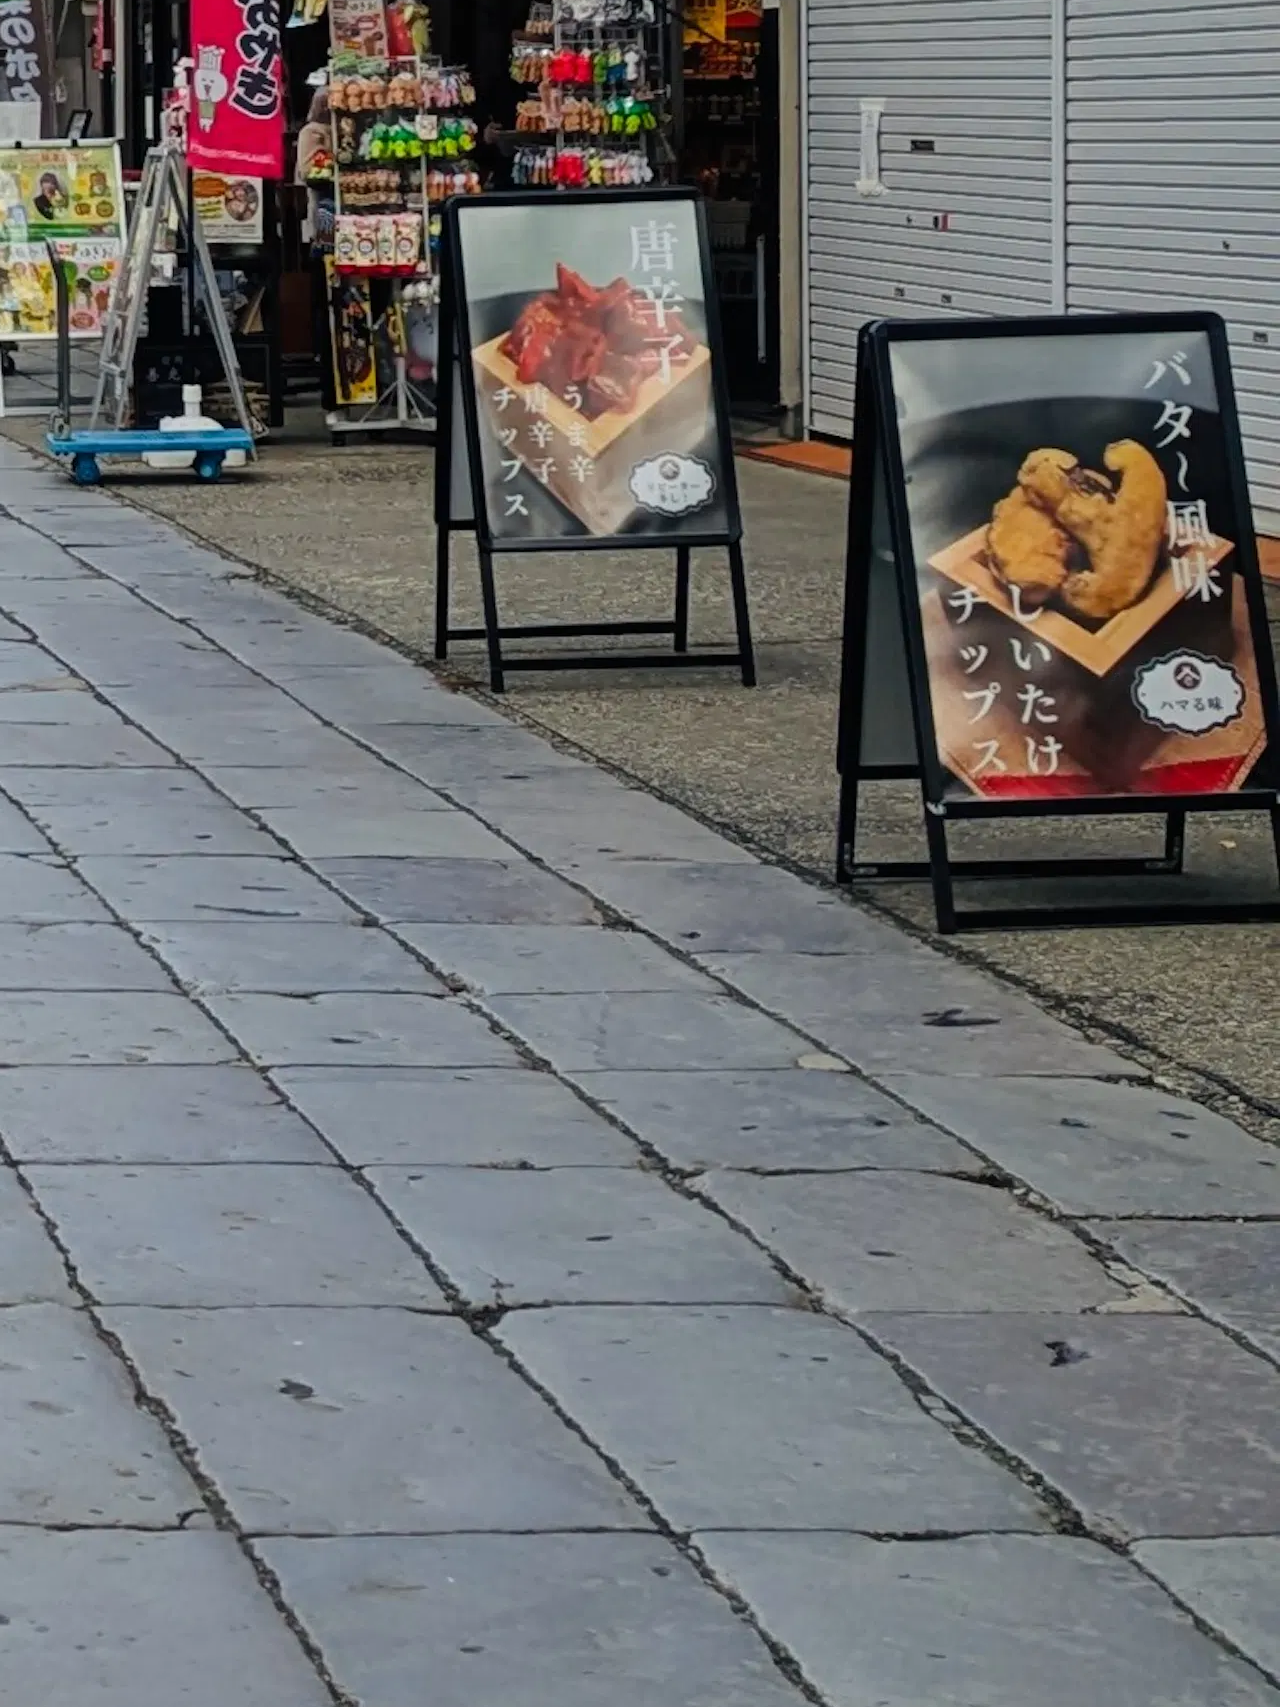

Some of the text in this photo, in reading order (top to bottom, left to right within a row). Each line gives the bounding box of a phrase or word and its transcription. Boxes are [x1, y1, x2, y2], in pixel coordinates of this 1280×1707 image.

[629, 220, 691, 385] 唐辛子
[492, 386, 529, 517] チップス
[524, 387, 558, 484] 唐辛子
[563, 385, 596, 483] うま辛
[948, 587, 1008, 776] チップス
[1007, 584, 1064, 776] しいたけ
